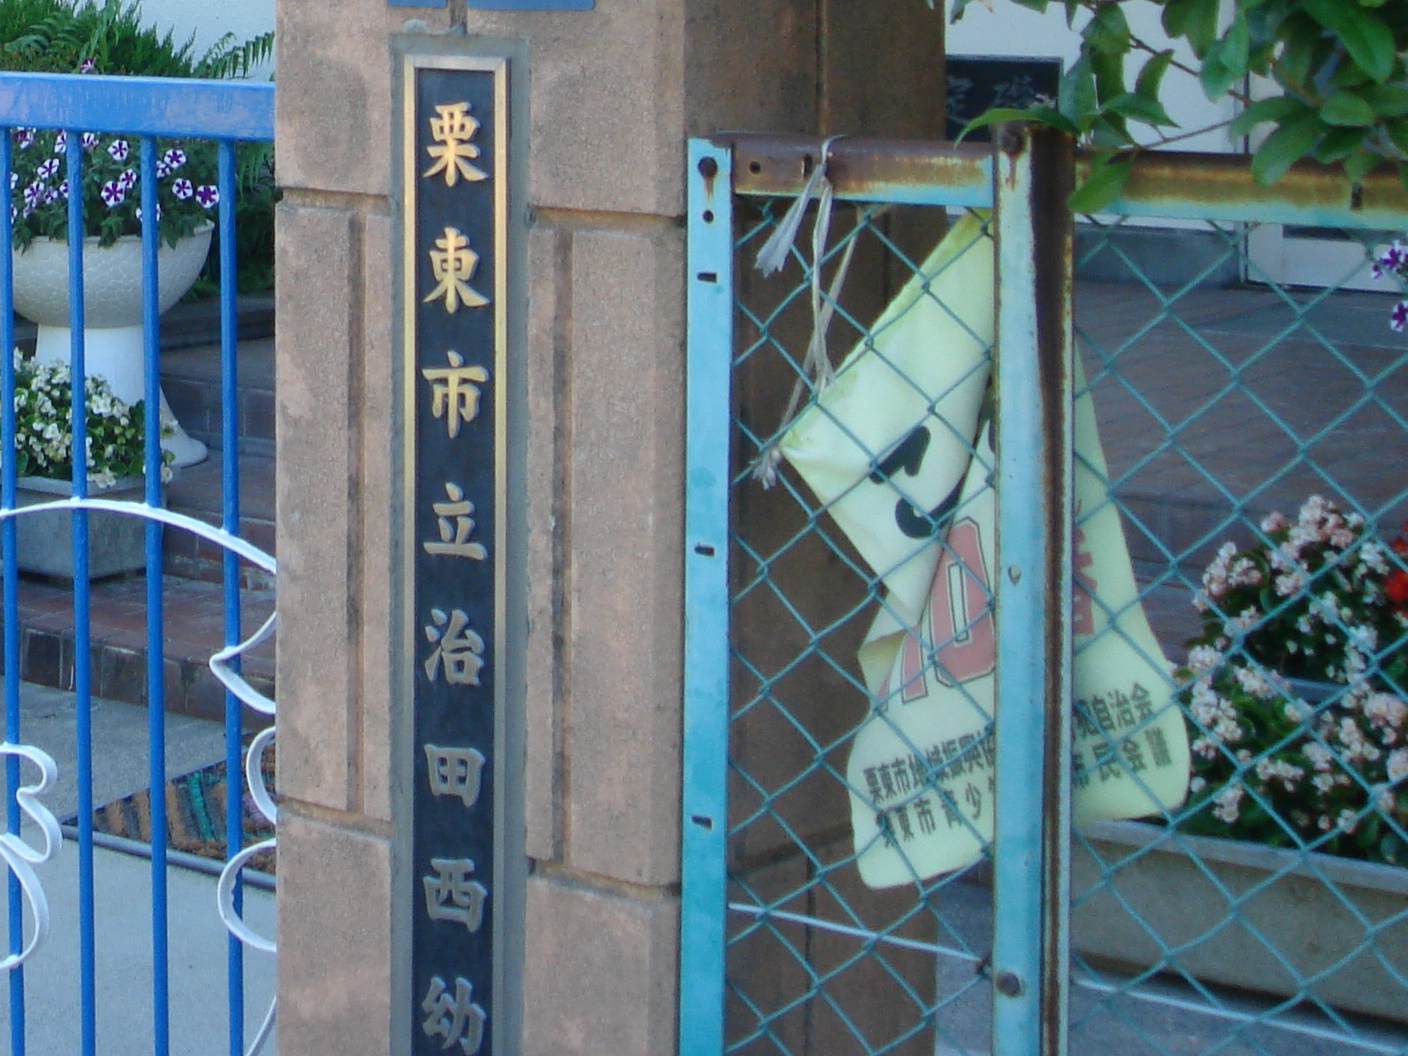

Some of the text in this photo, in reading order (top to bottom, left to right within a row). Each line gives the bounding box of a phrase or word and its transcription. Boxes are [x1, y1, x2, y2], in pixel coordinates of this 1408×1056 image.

[423, 101, 491, 1056] 栗東市立治田西幼
